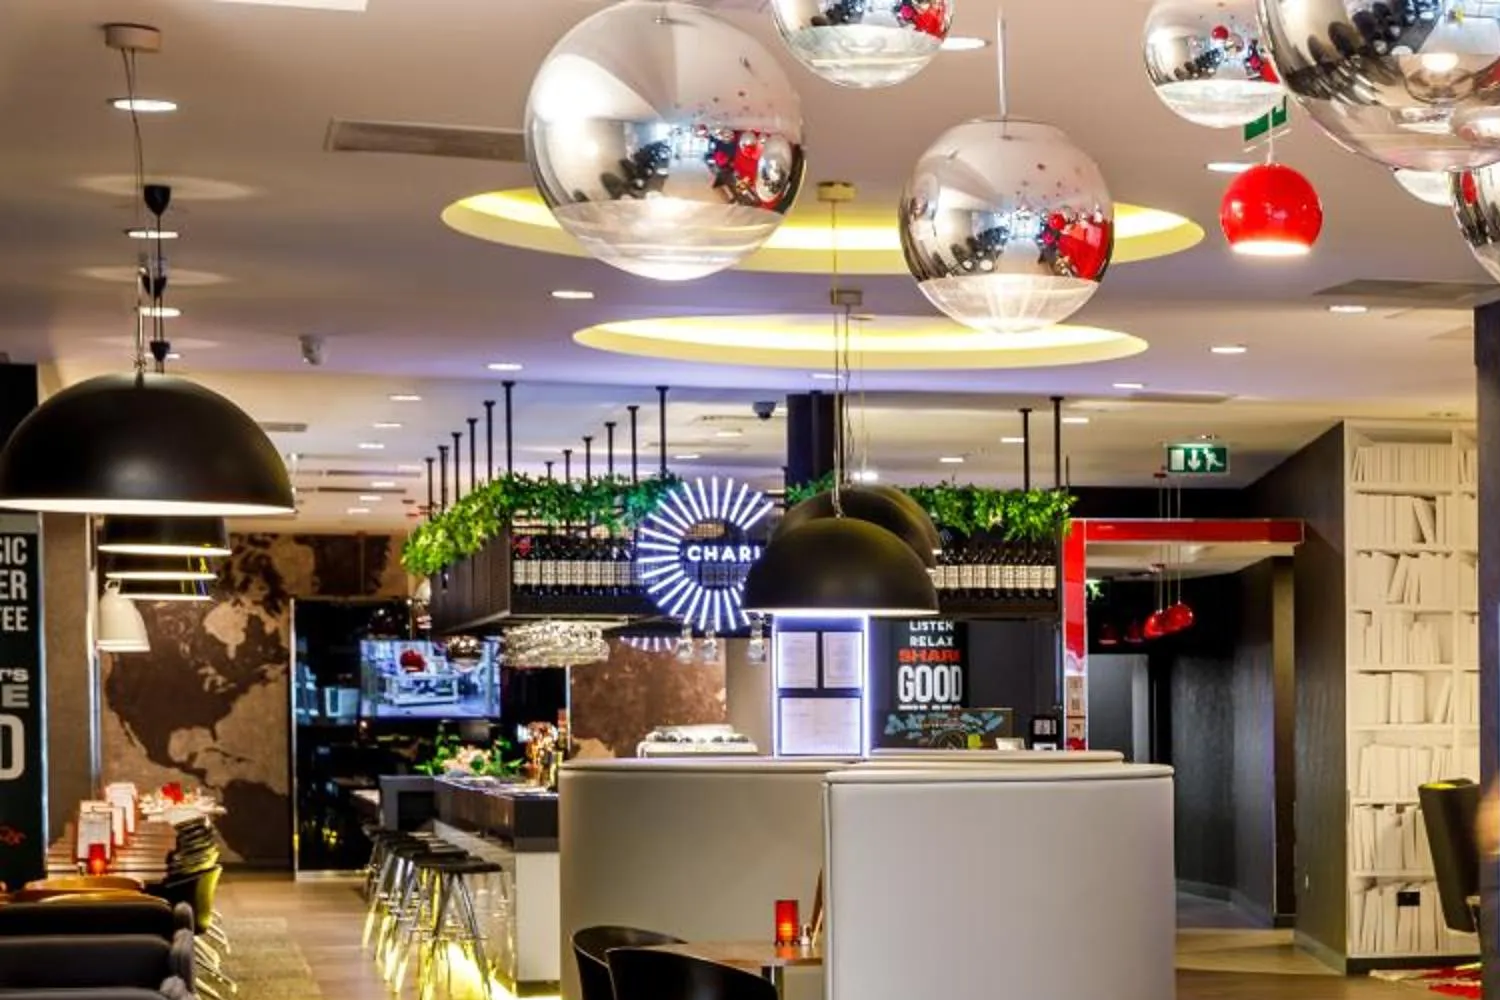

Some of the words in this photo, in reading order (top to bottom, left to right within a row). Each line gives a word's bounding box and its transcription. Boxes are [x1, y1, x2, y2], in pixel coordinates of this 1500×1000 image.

[0, 606, 28, 631] EE
[909, 636, 953, 647] RELAX
[898, 665, 962, 702] GOOD
